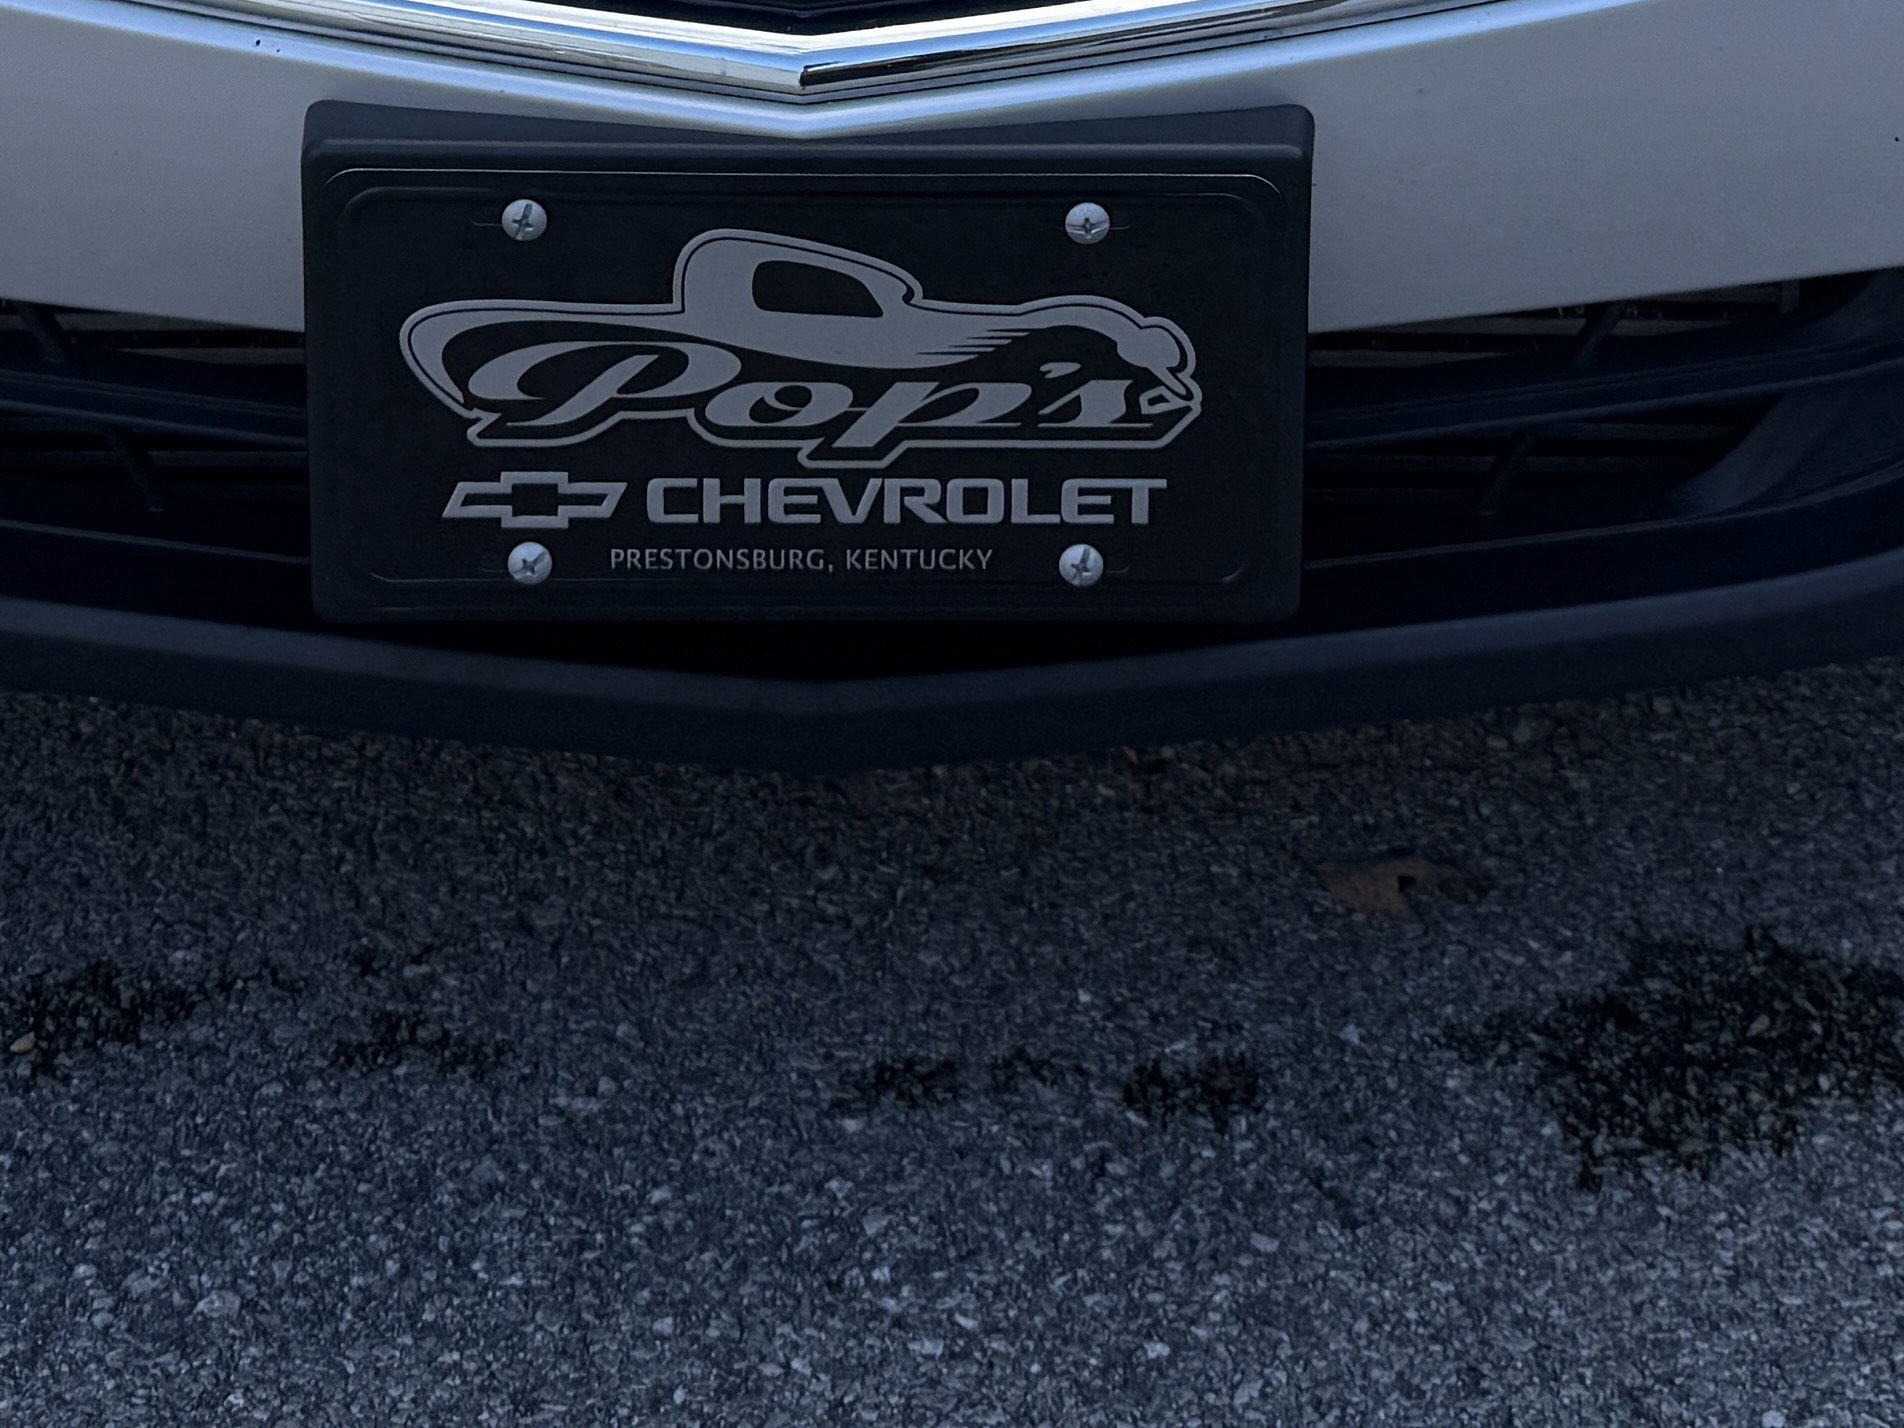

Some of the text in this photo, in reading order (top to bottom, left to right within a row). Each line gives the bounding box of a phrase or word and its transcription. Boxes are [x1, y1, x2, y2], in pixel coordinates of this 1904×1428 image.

[465, 340, 1156, 450] Pop's
[646, 477, 1169, 526] CHEVROLET
[610, 547, 994, 574] PRESTONSBURG, KENTUCKY
